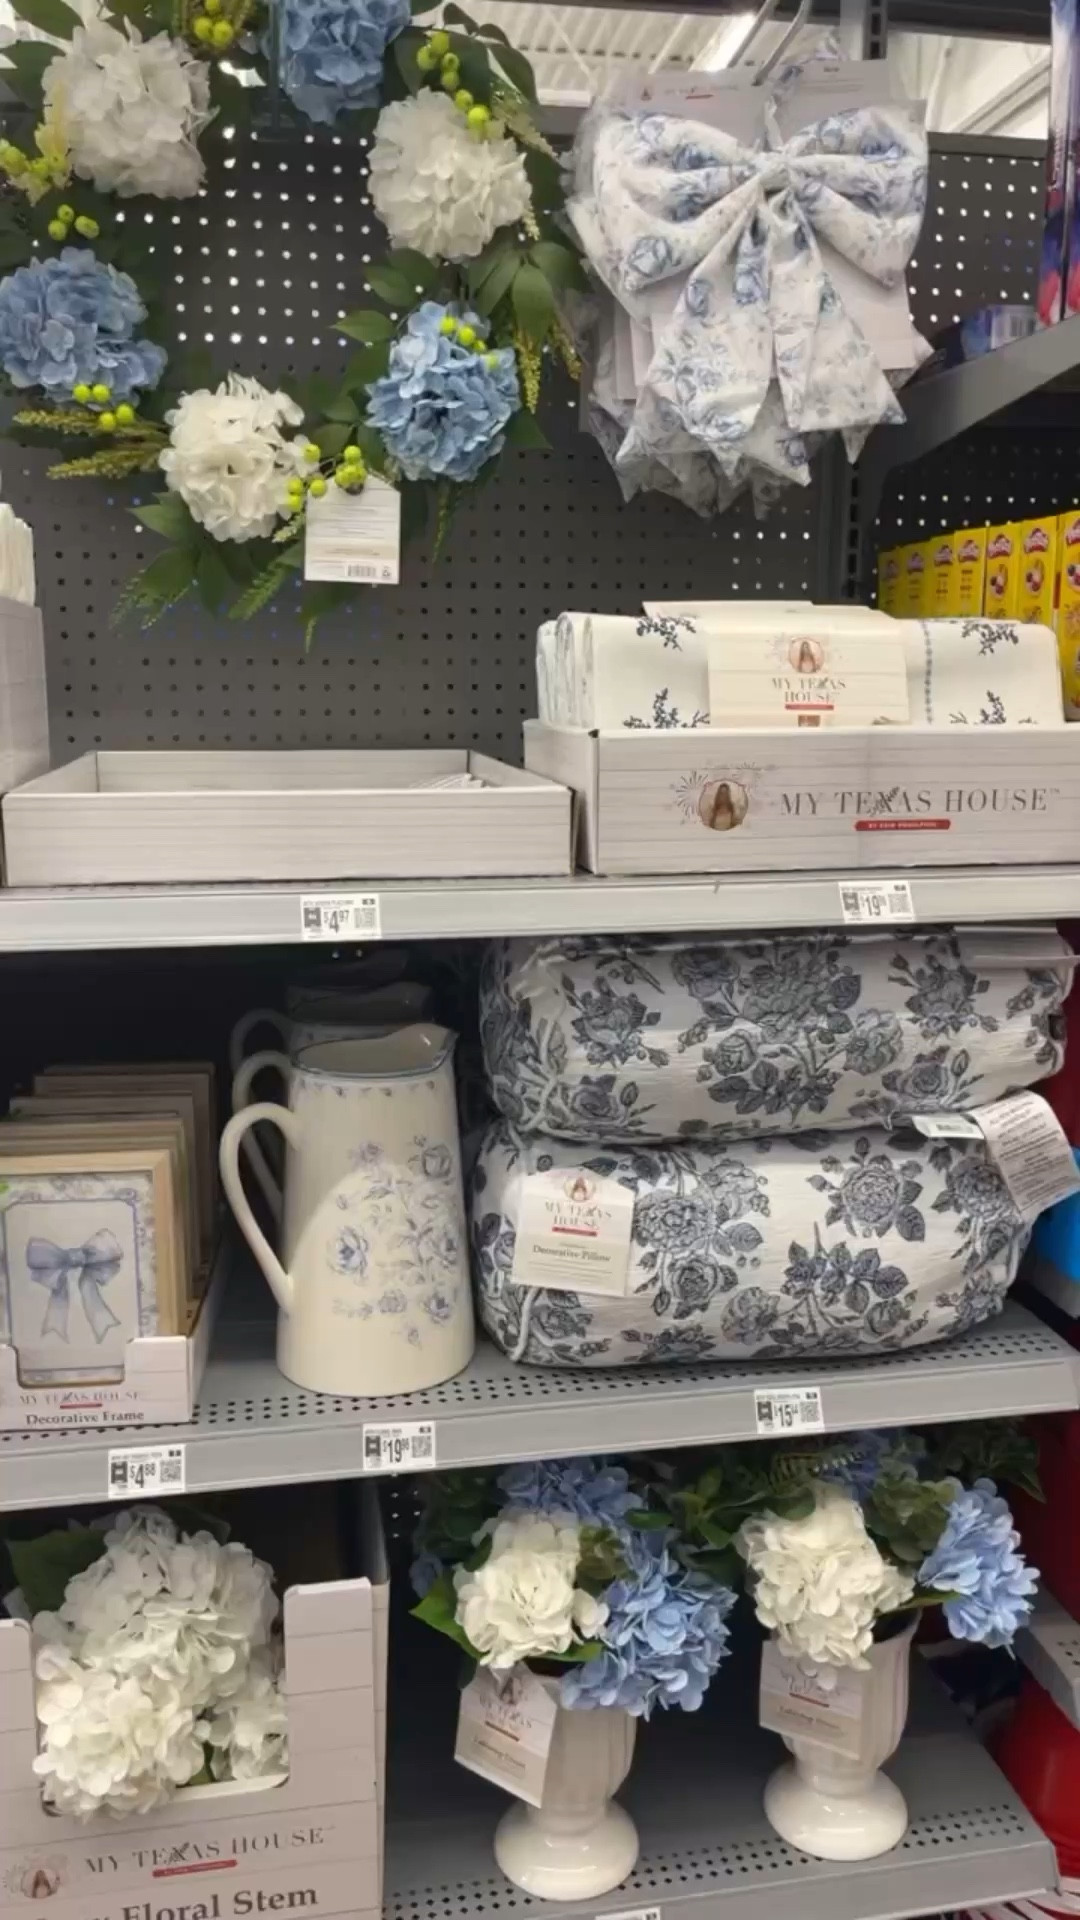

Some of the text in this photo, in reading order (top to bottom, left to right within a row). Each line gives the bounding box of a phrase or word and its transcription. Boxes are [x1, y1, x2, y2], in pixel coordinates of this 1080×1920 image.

[800, 677, 846, 689] TEXAS
[780, 792, 822, 815] MY
[834, 786, 931, 815] TEXAS
[25, 1411, 145, 1425] Decorative Frame
[86, 1856, 119, 1873] MY
[132, 1841, 221, 1868] TEXAS
[119, 1888, 318, 1920] Floral Stem
